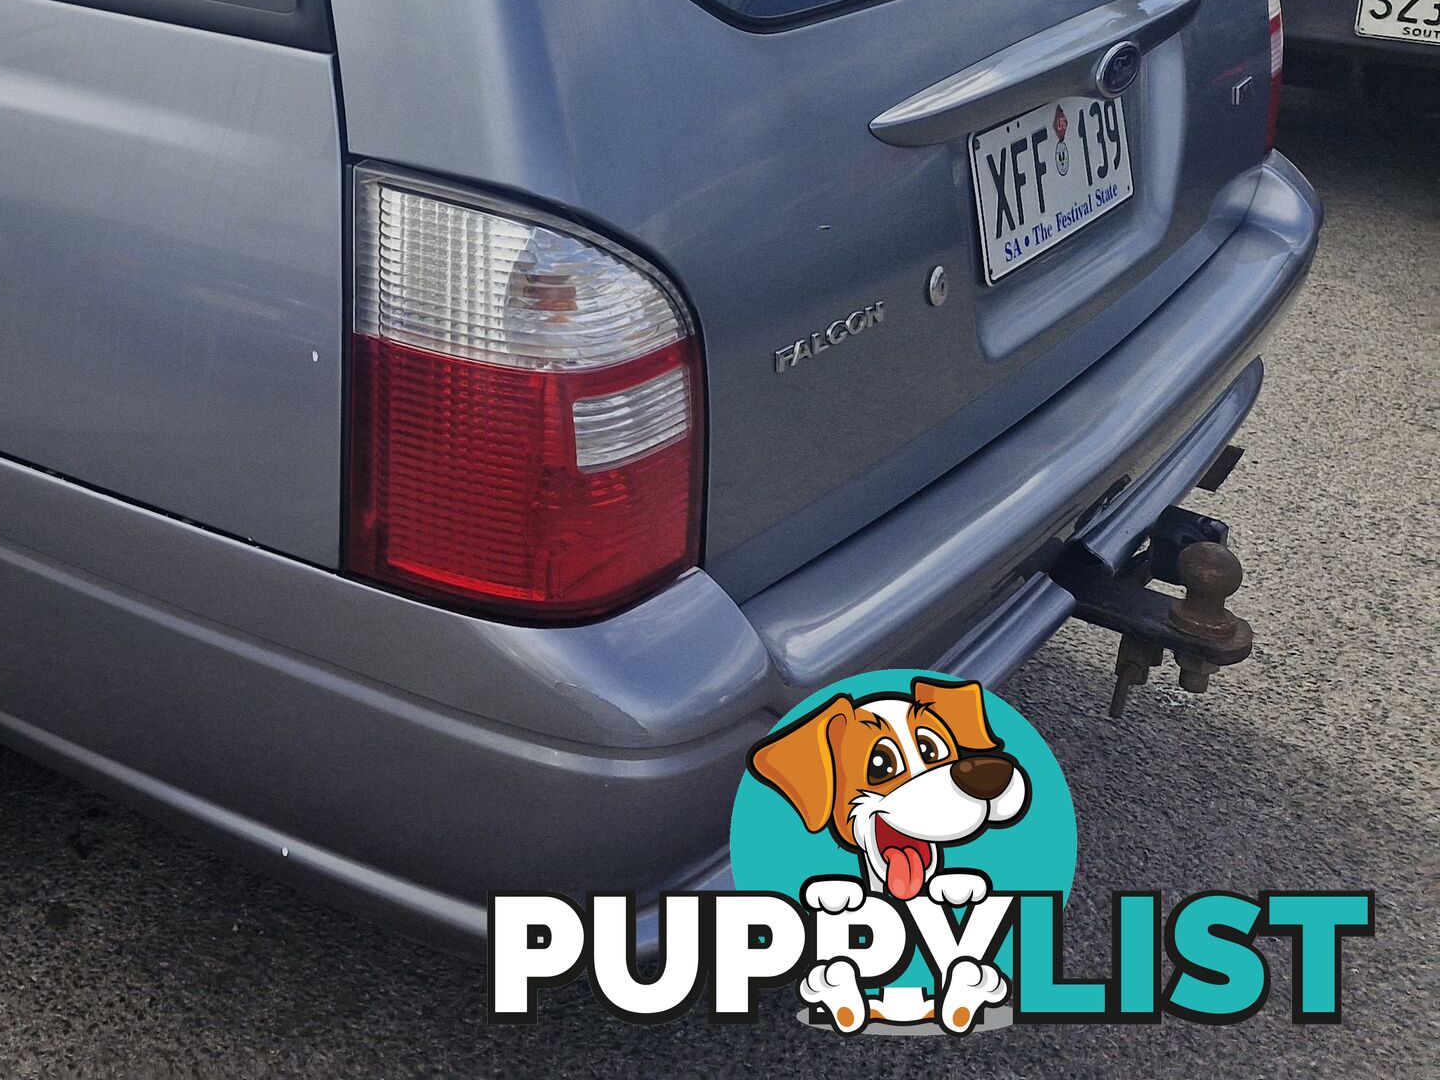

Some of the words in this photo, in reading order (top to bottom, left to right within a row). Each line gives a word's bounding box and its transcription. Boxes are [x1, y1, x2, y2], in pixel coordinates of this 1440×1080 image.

[986, 126, 1048, 240] XFF
[1078, 99, 1121, 186] 139
[1004, 238, 1022, 262] SA
[1032, 222, 1053, 245] The
[1055, 194, 1093, 232] Festival
[1095, 183, 1118, 207] State
[774, 301, 884, 373] FALCON
